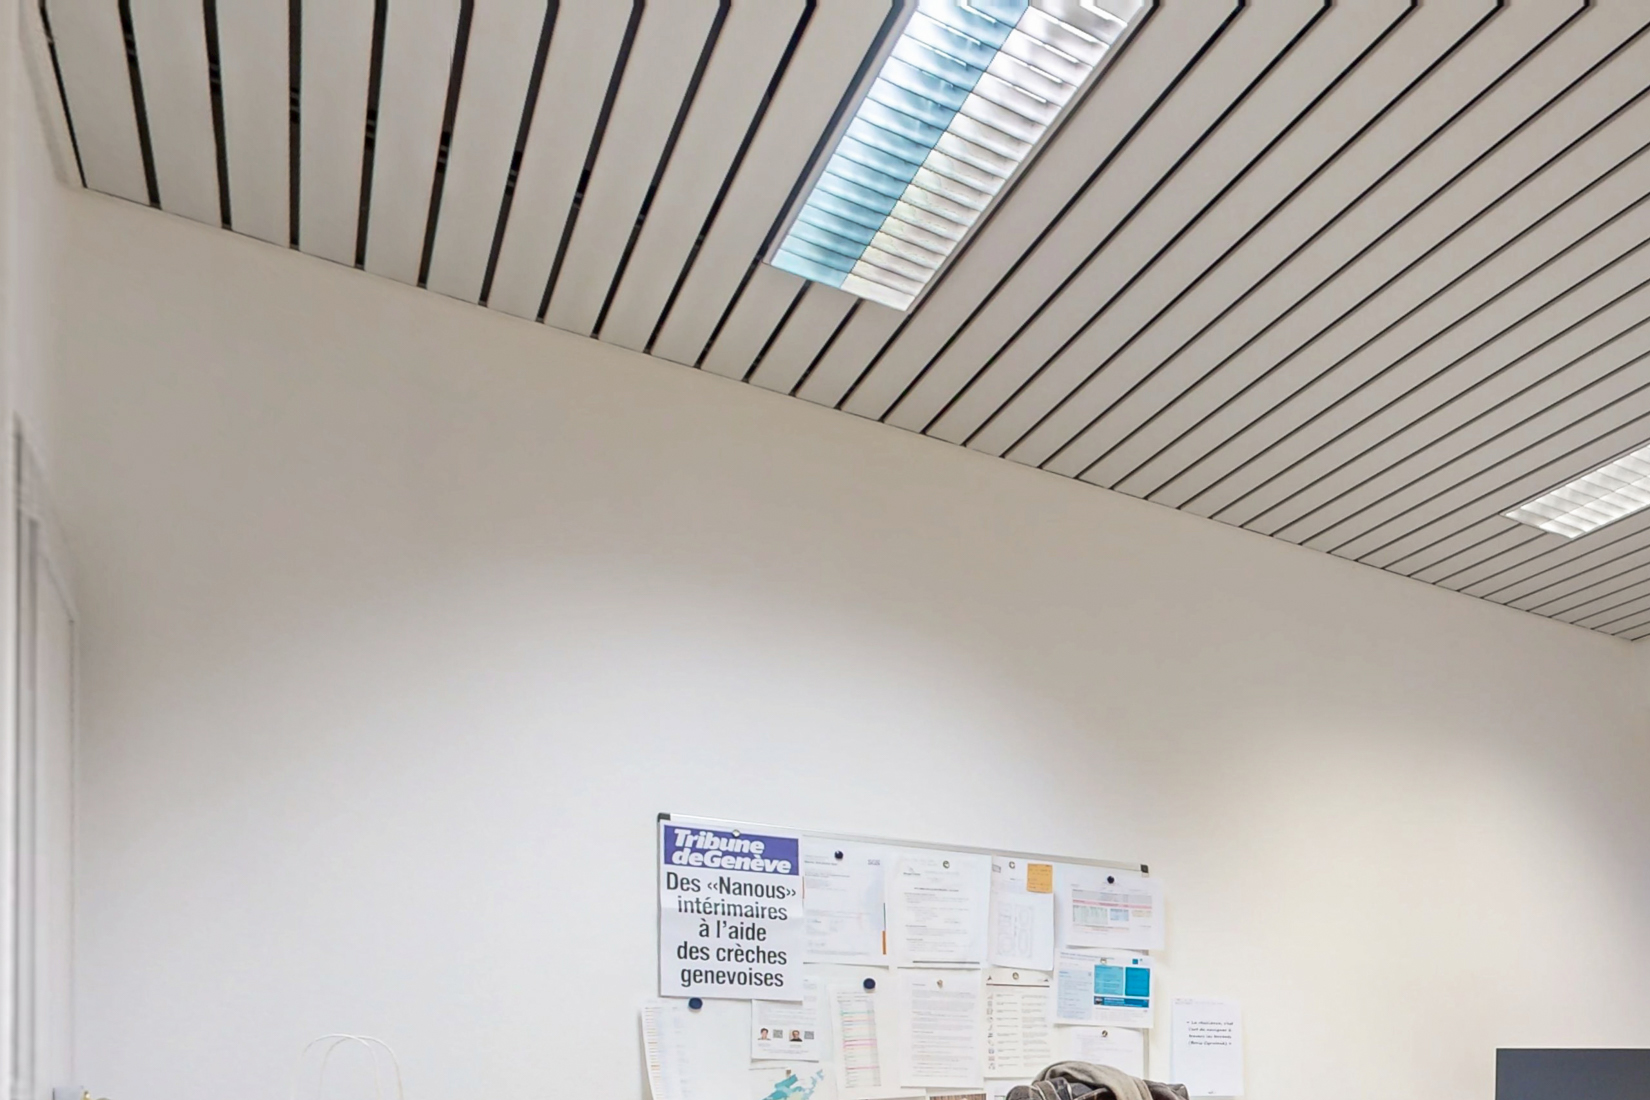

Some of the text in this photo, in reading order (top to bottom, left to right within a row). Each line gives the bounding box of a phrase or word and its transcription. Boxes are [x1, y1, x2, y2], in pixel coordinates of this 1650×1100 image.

[674, 828, 765, 854] Tribune
[671, 848, 792, 874] deGenève
[666, 871, 797, 900] Des «Nanous»
[677, 895, 788, 921] intérimaires
[698, 918, 710, 938] à
[676, 941, 787, 965] des crèches
[680, 967, 784, 988] genevoises
